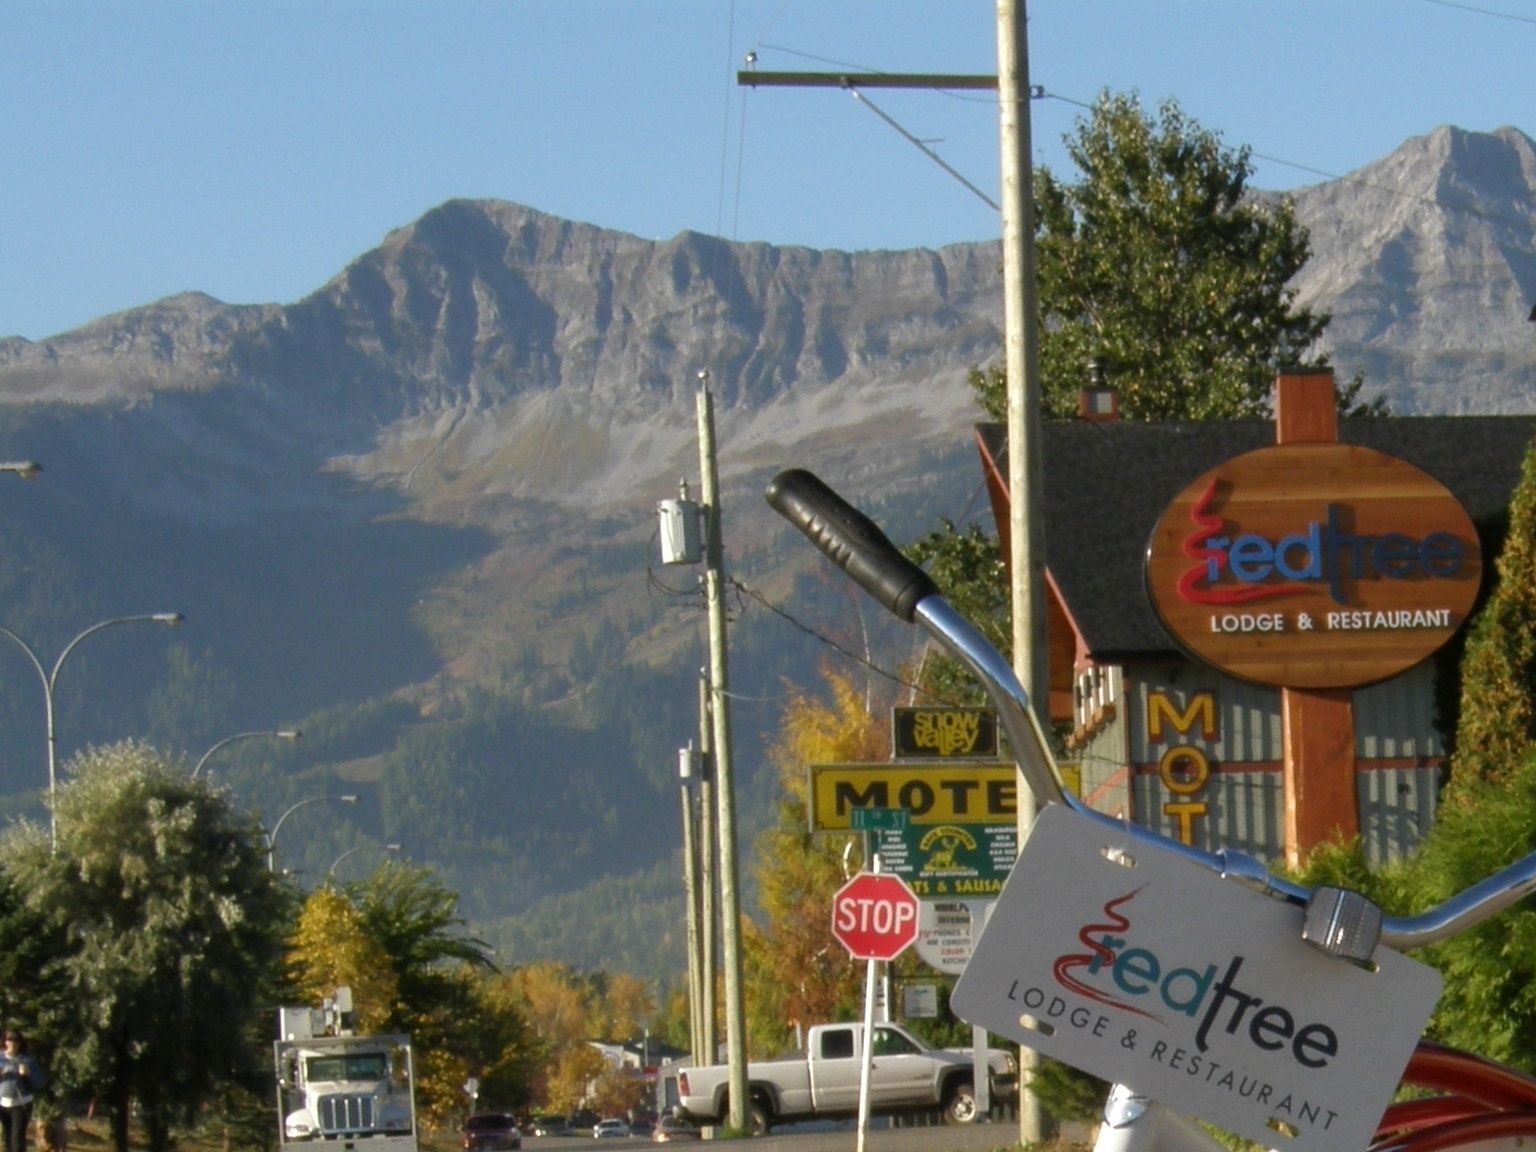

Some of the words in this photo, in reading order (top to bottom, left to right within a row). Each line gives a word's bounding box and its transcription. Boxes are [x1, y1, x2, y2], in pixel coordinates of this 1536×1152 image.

[1206, 503, 1466, 605] redtree
[1210, 613, 1284, 632] LODGE
[1297, 614, 1314, 630] &
[1327, 609, 1451, 630] RESTAURANT
[913, 711, 980, 731] snow
[913, 727, 980, 756] valley
[1147, 690, 1220, 846] MOT
[835, 780, 1017, 816] MOTE
[937, 881, 947, 892] &
[955, 879, 1004, 892] SAUSA
[836, 898, 915, 935] STOP
[1087, 934, 1339, 1069] redtree
[1007, 980, 1110, 1038] LODGE
[1121, 1028, 1137, 1050] &
[1150, 1041, 1340, 1132] RESTAURANT
